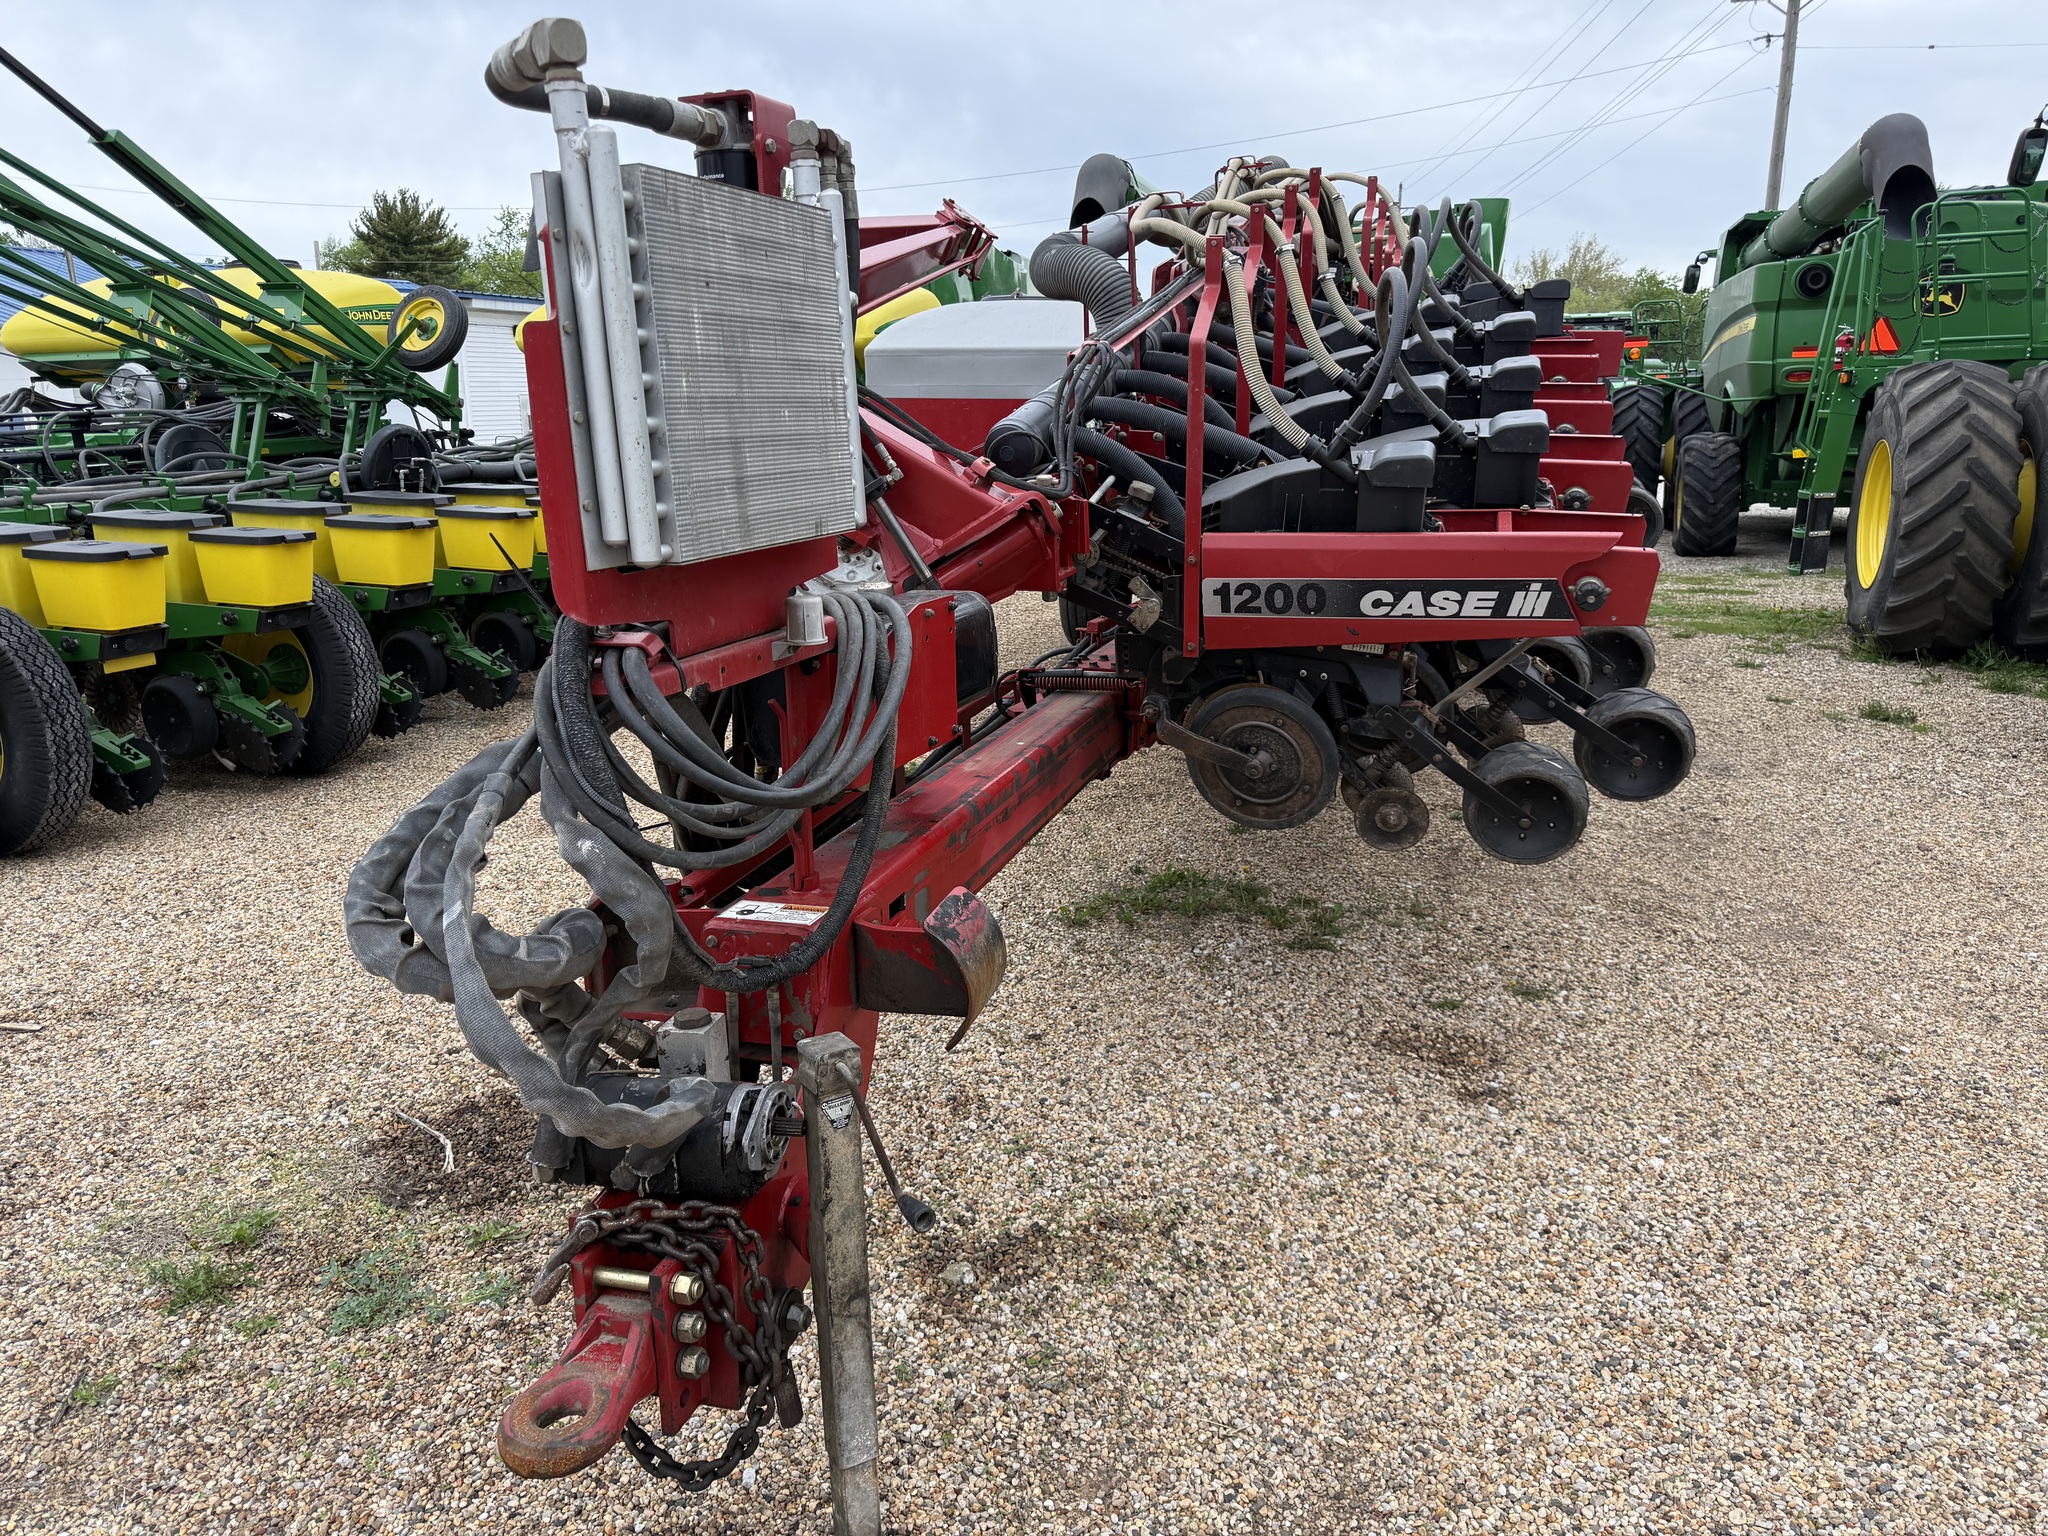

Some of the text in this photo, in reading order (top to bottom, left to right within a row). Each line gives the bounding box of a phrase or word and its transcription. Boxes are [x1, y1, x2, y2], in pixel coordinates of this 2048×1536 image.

[347, 309, 394, 320] JOHN DEE
[1213, 582, 1327, 615] 1200
[1359, 590, 1500, 617] CASE
